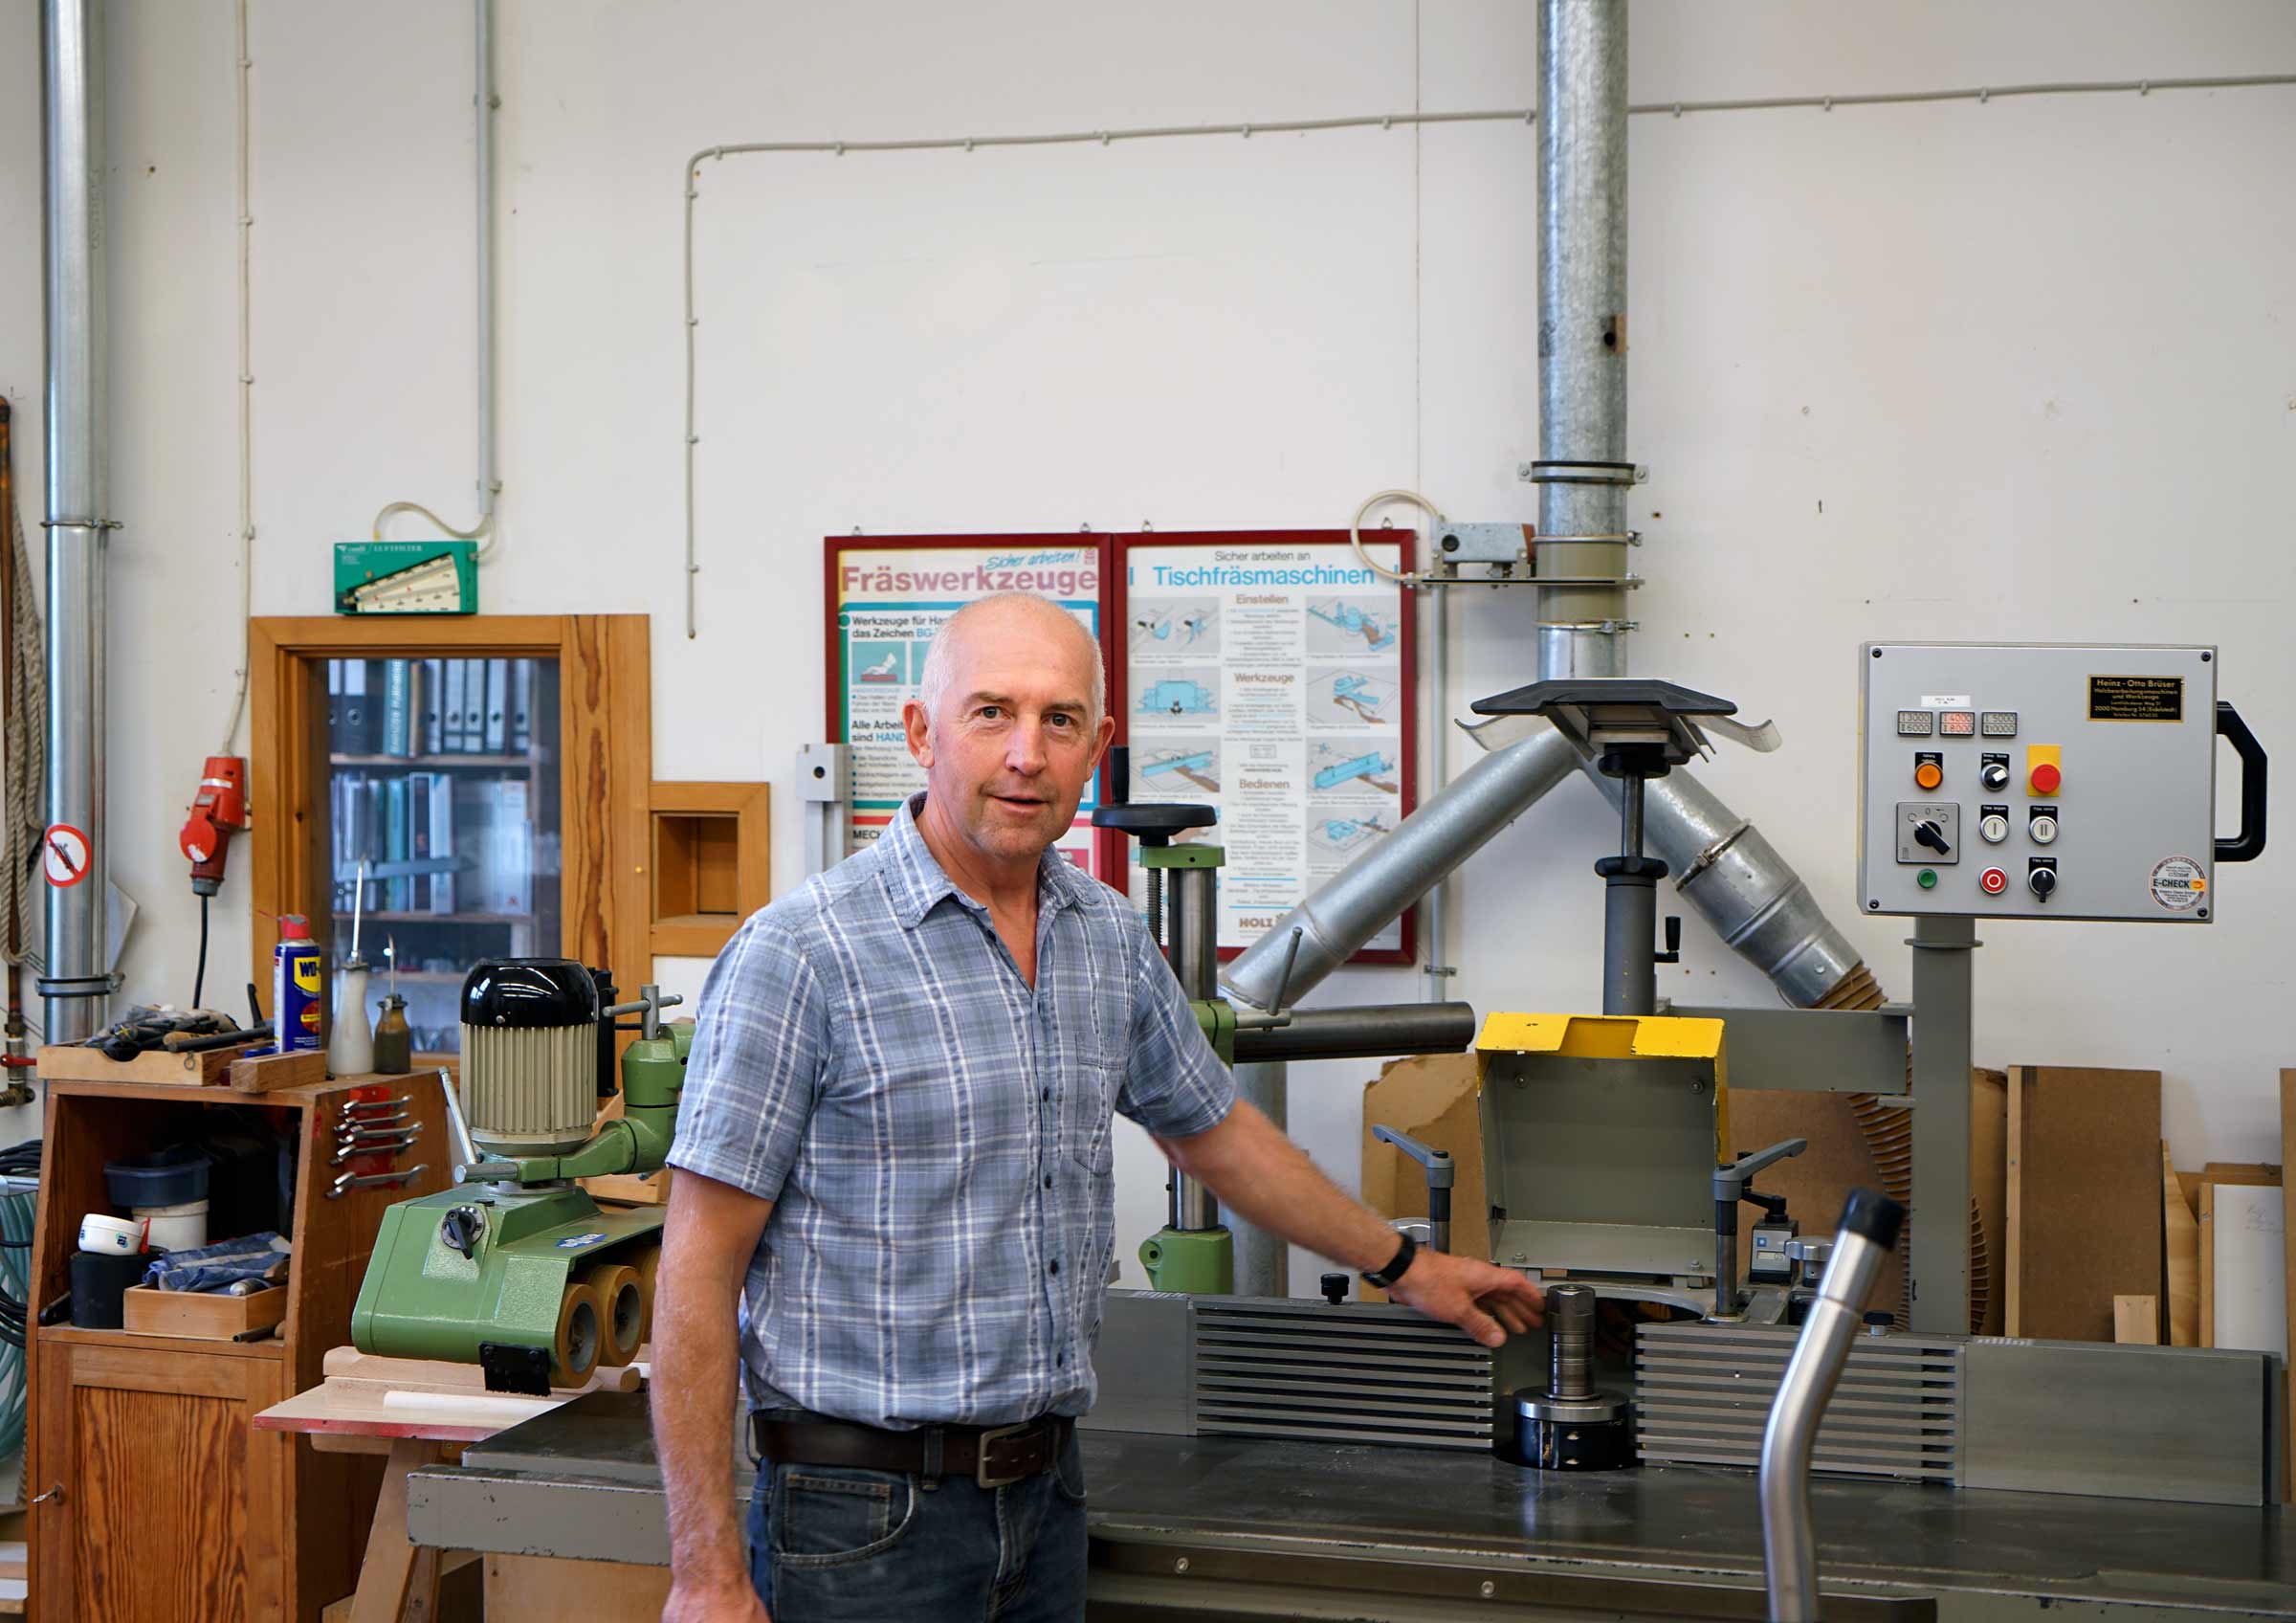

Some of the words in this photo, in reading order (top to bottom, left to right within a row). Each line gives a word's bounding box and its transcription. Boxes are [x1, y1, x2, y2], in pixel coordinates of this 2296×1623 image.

[1215, 551, 1248, 562] Sicher
[1251, 550, 1293, 561] arbeiten
[1296, 551, 1311, 561] an
[985, 554, 1026, 570] Sicher
[841, 566, 1098, 596] Fräswerkzeuge
[1152, 565, 1375, 586] Tischfräsmaschinen
[1236, 594, 1289, 605] Einstellen
[851, 616, 909, 627] Werkzeuge
[912, 616, 926, 625] für
[851, 629, 871, 637] das
[873, 629, 914, 637] Zeichen
[916, 628, 938, 637] BG-
[1234, 673, 1294, 684] Werkzeuge
[851, 720, 871, 729] Alle
[851, 732, 872, 742] sind
[1239, 778, 1290, 789] Bedienen
[2153, 878, 2190, 889] E-CHECK
[298, 961, 321, 978] WD-
